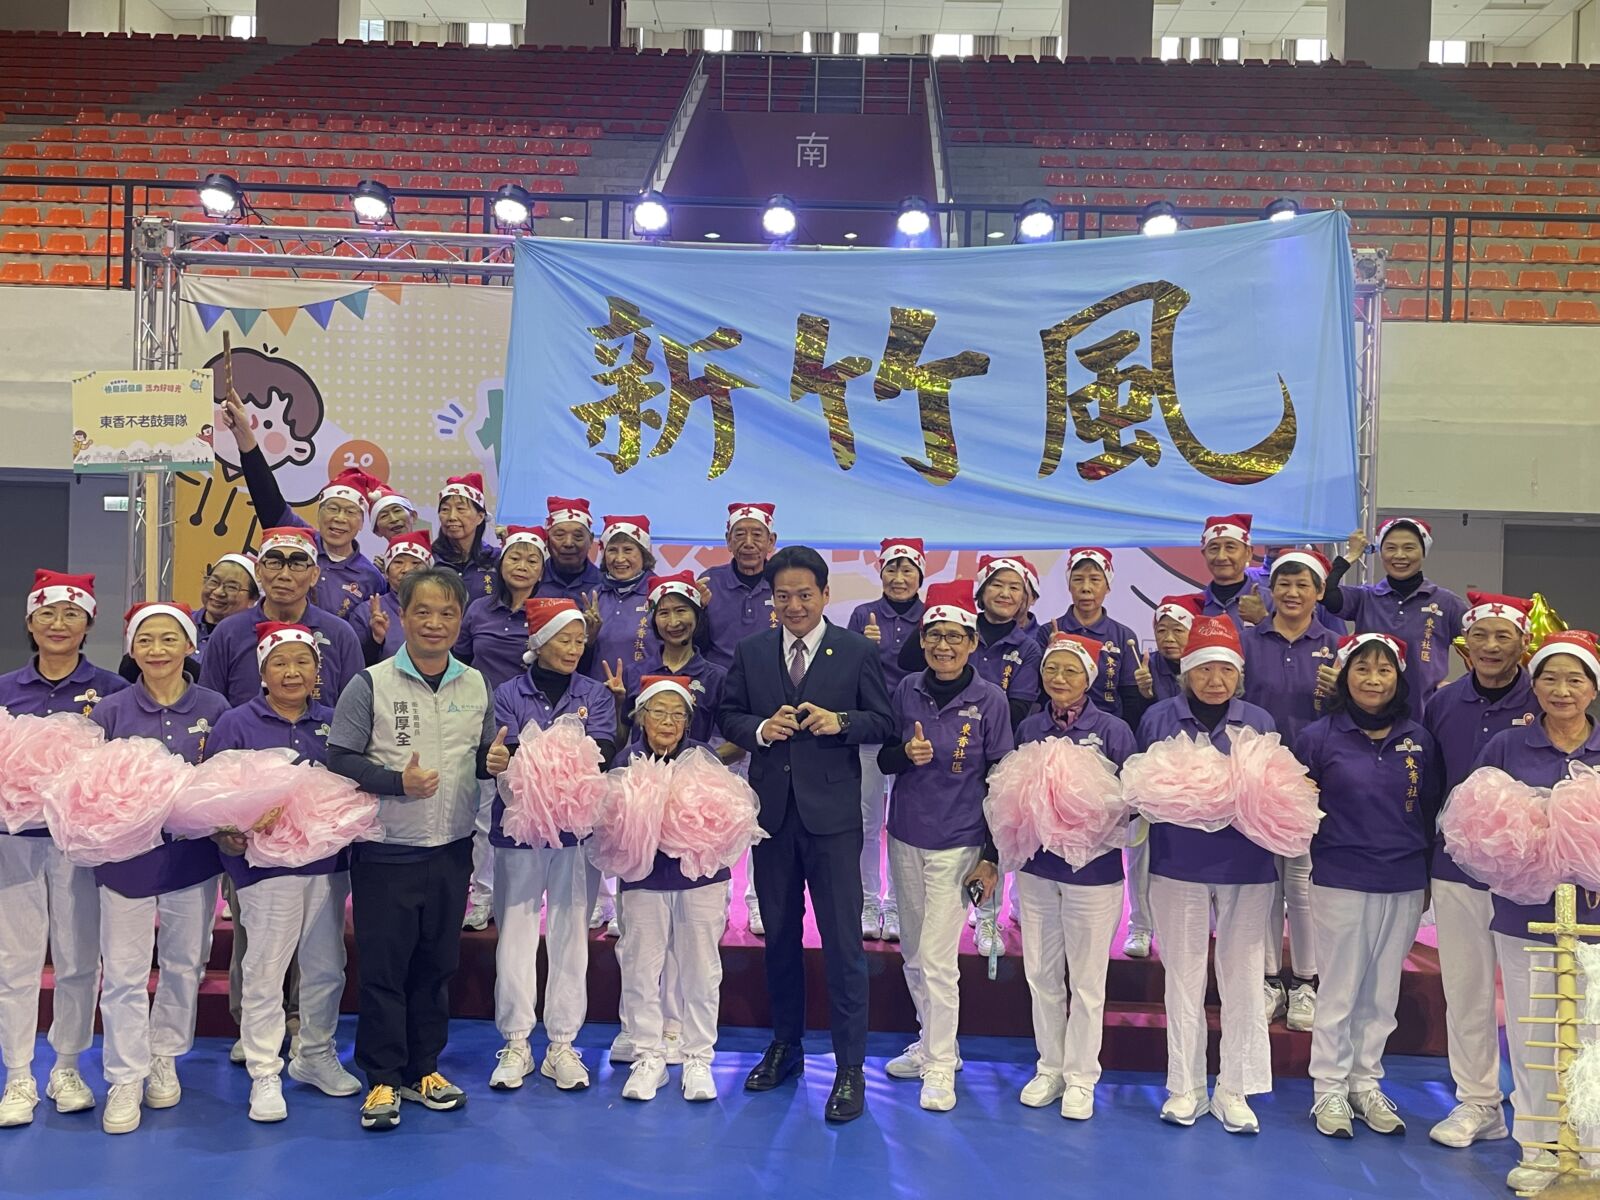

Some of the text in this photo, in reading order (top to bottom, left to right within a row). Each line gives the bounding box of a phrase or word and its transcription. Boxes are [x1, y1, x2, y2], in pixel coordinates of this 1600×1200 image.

[795, 131, 829, 168] 南
[570, 279, 1298, 486] 新竹風
[99, 414, 187, 429] 東香不老鼓舞隊
[634, 617, 648, 662] 東香社區
[1421, 618, 1435, 662] 東香社區
[1104, 656, 1117, 702] 東香社區
[393, 701, 411, 747] 陳厚全
[952, 722, 971, 773] 東香社區
[1405, 756, 1419, 813] 東香社區
